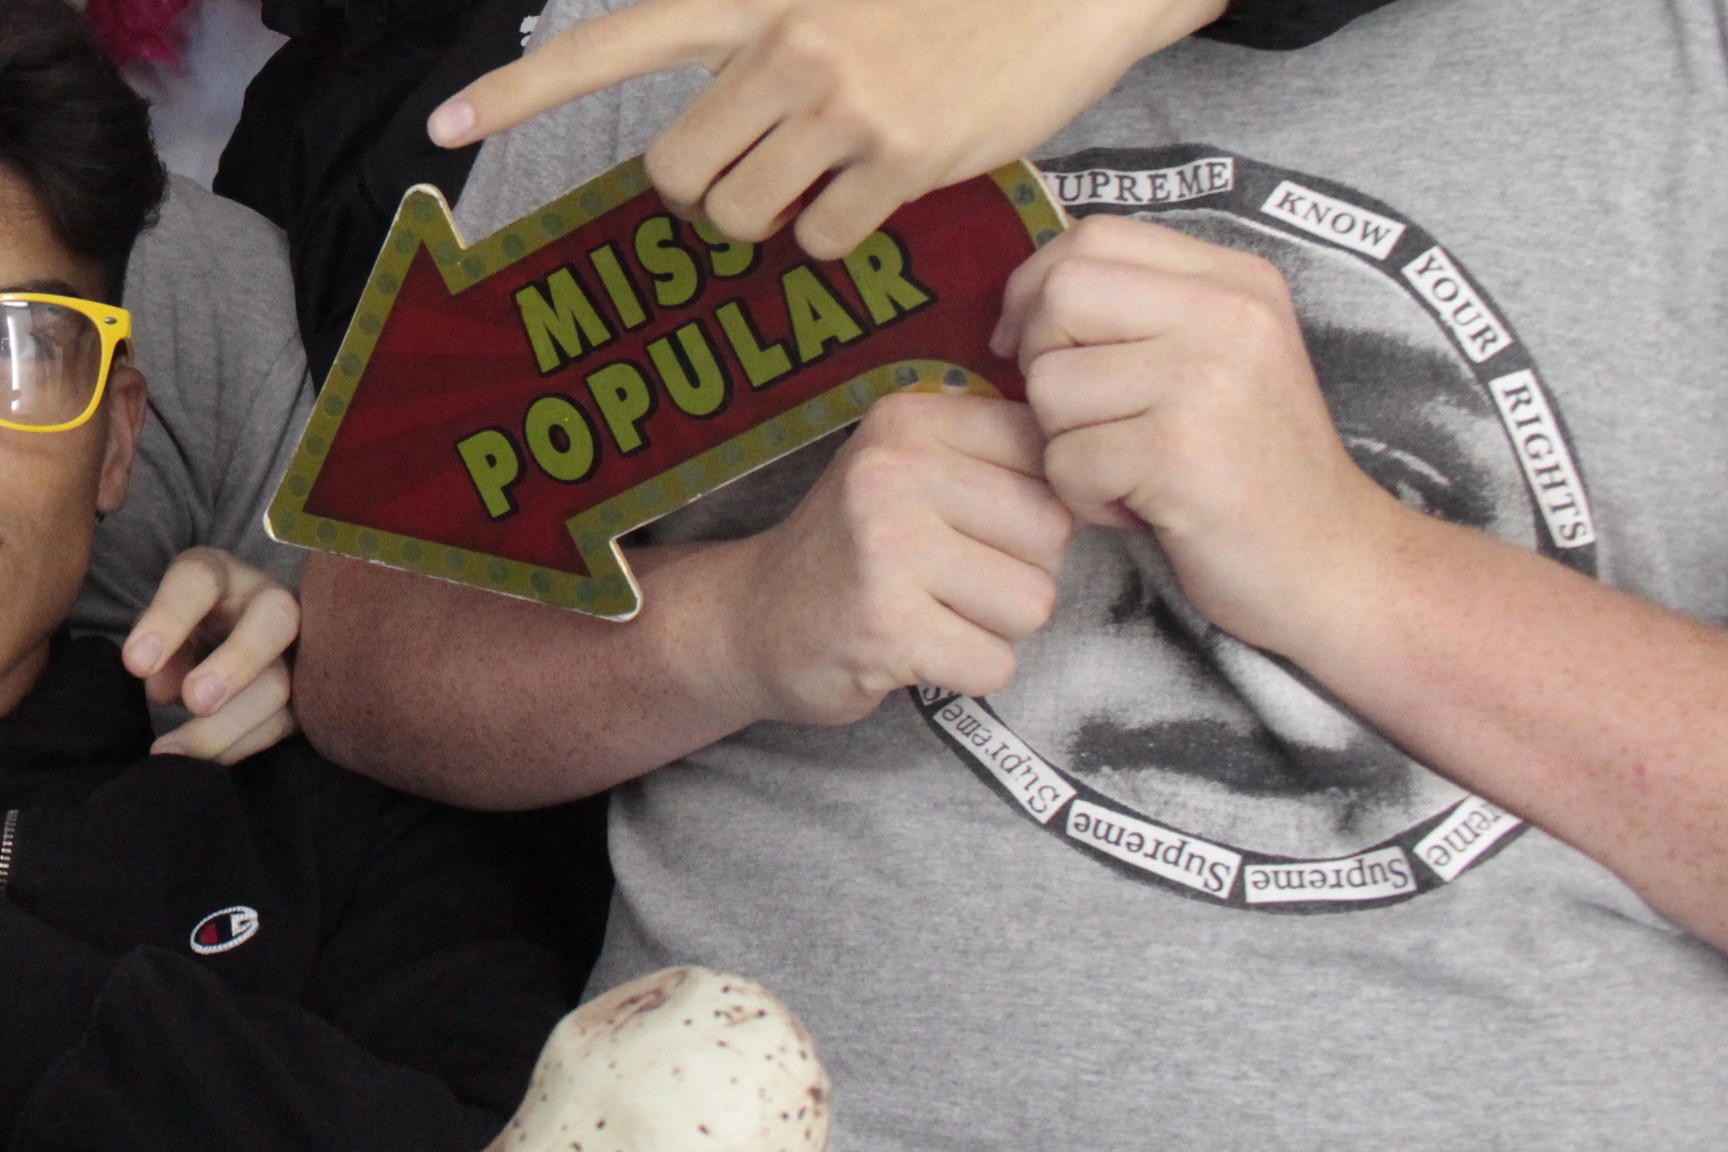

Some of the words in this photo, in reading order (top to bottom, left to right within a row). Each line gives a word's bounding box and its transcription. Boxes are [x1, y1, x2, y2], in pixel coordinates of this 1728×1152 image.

[454, 231, 936, 521] POPULAR
[1045, 162, 1229, 203] UPREME
[1275, 190, 1392, 247] KNOW
[1415, 253, 1499, 353] YOUR
[1504, 382, 1587, 541] RIGHTS
[942, 703, 1061, 814] Supreme
[1073, 811, 1231, 893] Supreme
[1250, 857, 1409, 891] Supreme
[1426, 798, 1503, 867] reme
